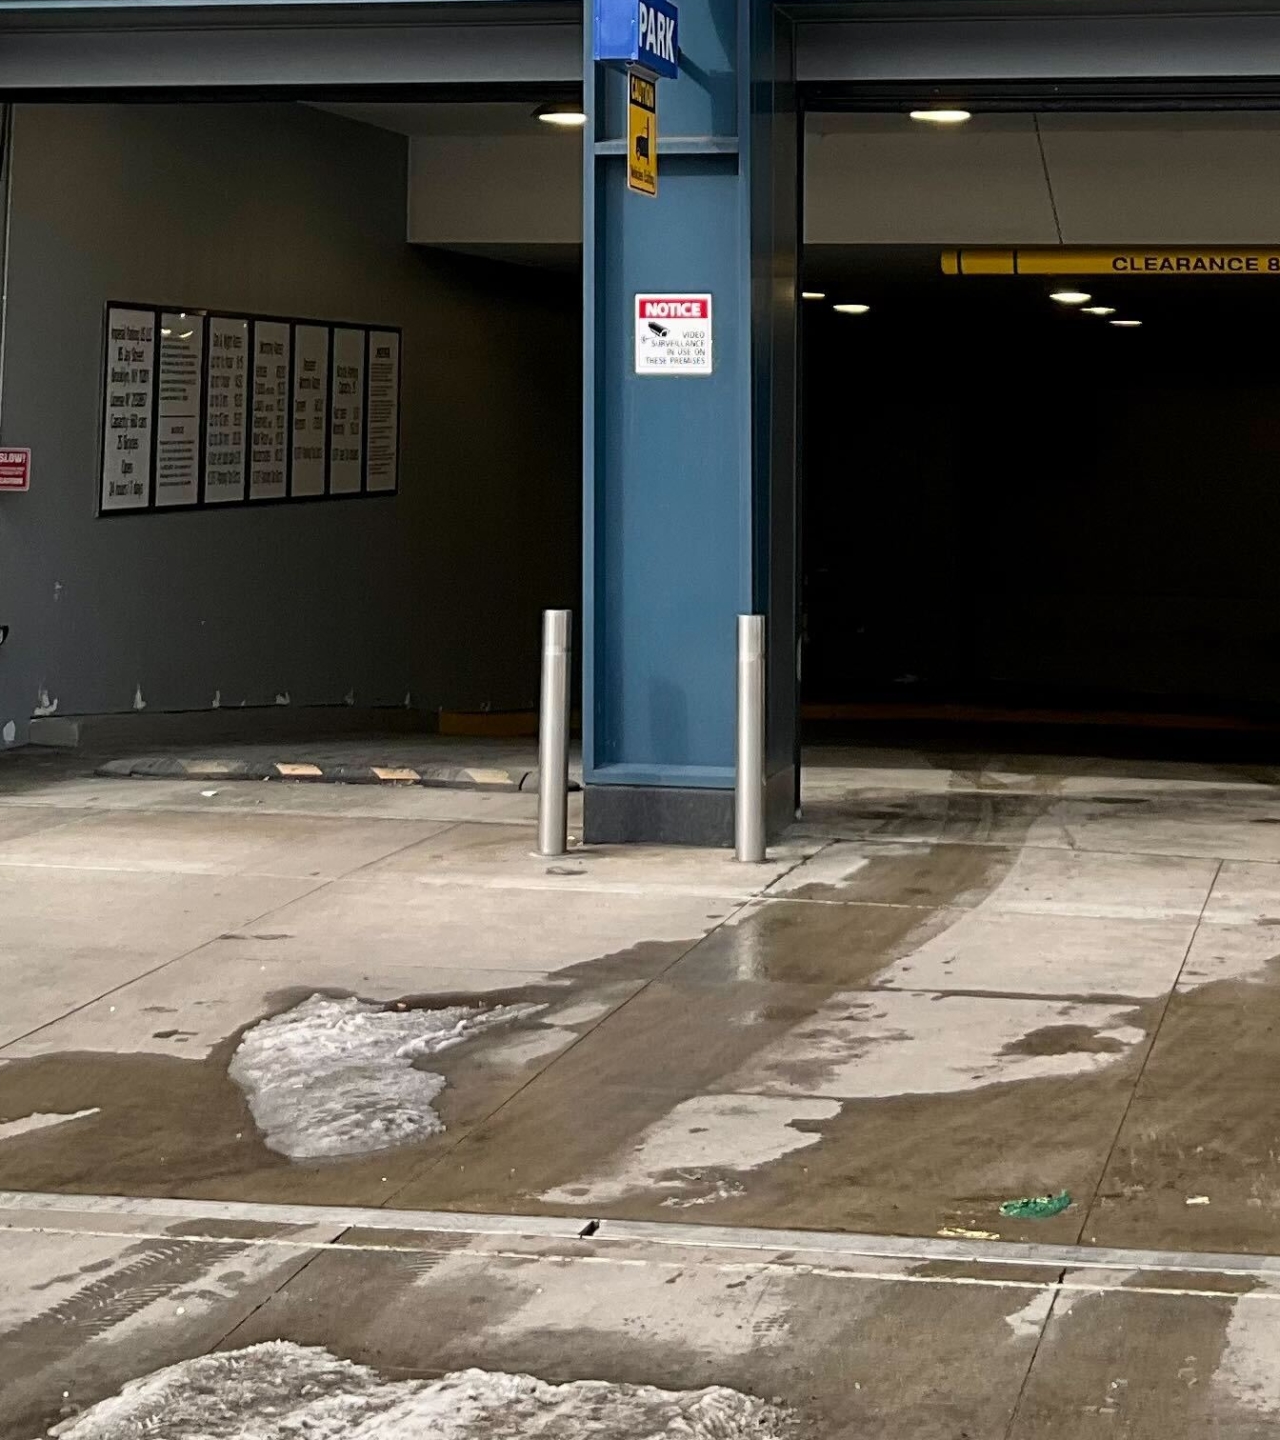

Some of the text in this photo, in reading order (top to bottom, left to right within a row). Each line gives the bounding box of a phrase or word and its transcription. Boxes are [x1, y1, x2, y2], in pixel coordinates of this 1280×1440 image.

[638, 1, 676, 64] PARK
[1111, 255, 1260, 273] CLEARANCE
[645, 302, 701, 318] NOTICE
[682, 331, 705, 339] VIDEO
[666, 348, 706, 356] IN USE ON
[646, 357, 667, 365] THESE
